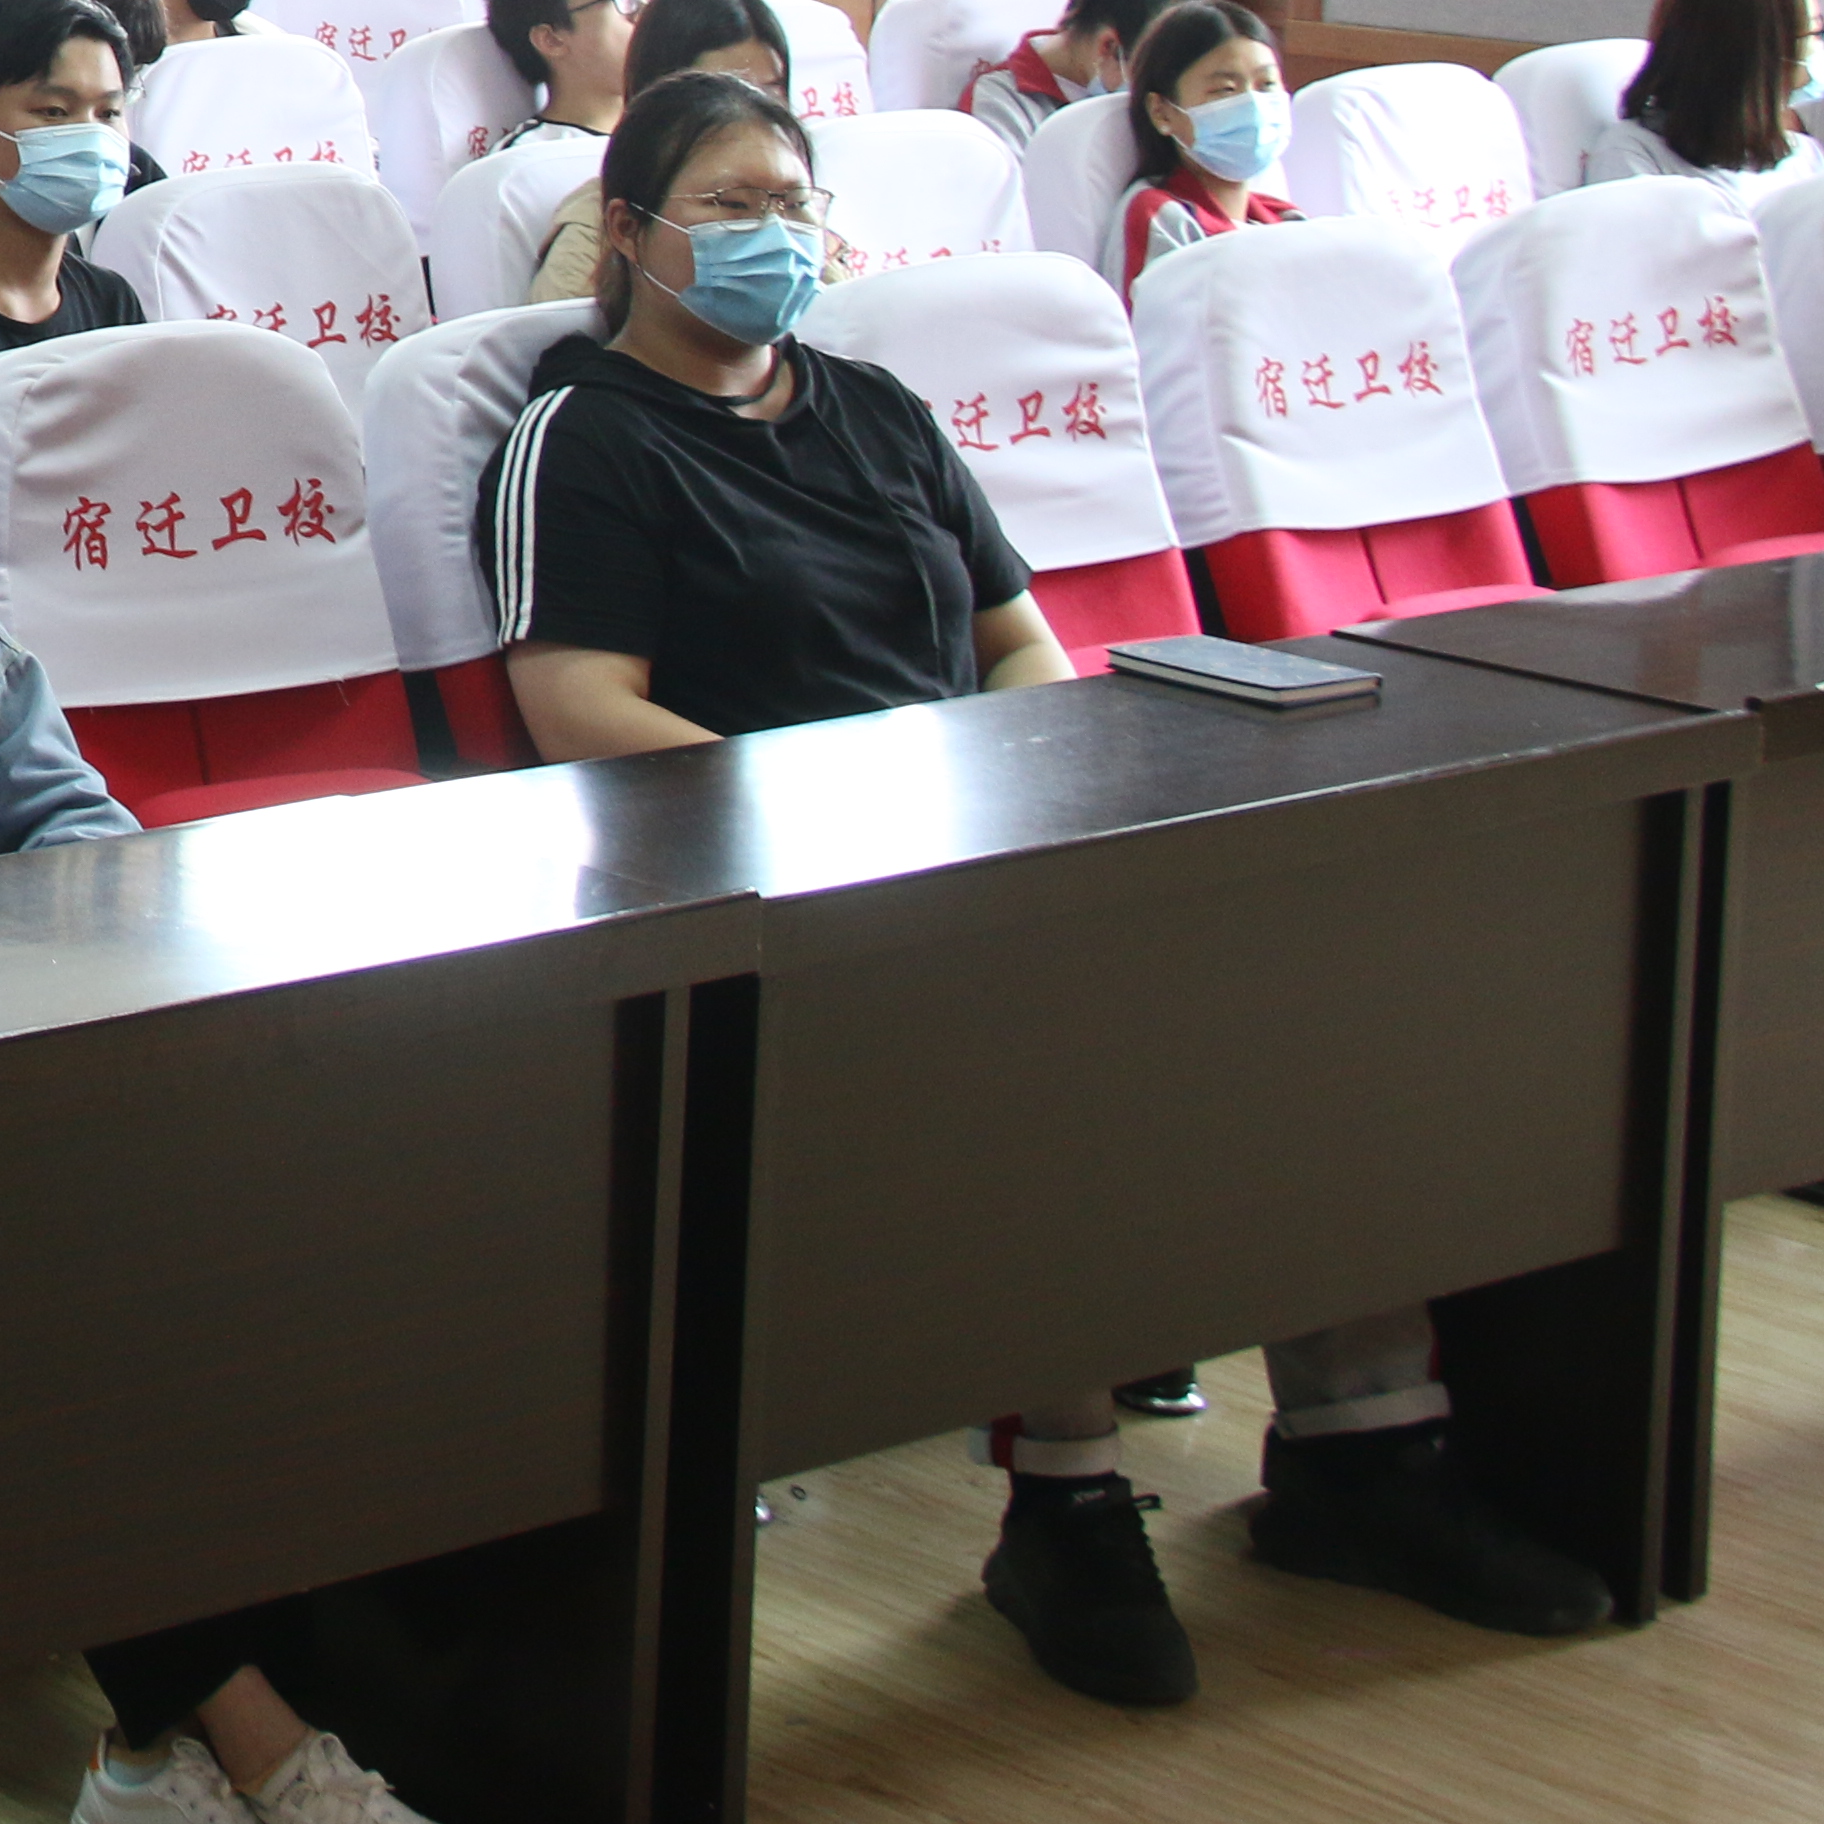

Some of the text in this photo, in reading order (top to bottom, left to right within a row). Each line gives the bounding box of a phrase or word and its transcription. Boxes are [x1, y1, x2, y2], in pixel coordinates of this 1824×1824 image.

[315, 21, 439, 63] 宿迁卫
[1566, 294, 1740, 376] 宿迁卫校
[925, 380, 1109, 453] 迁卫校
[1256, 339, 1444, 418] 宿迁卫校
[61, 476, 337, 570] 宿迁卫校
